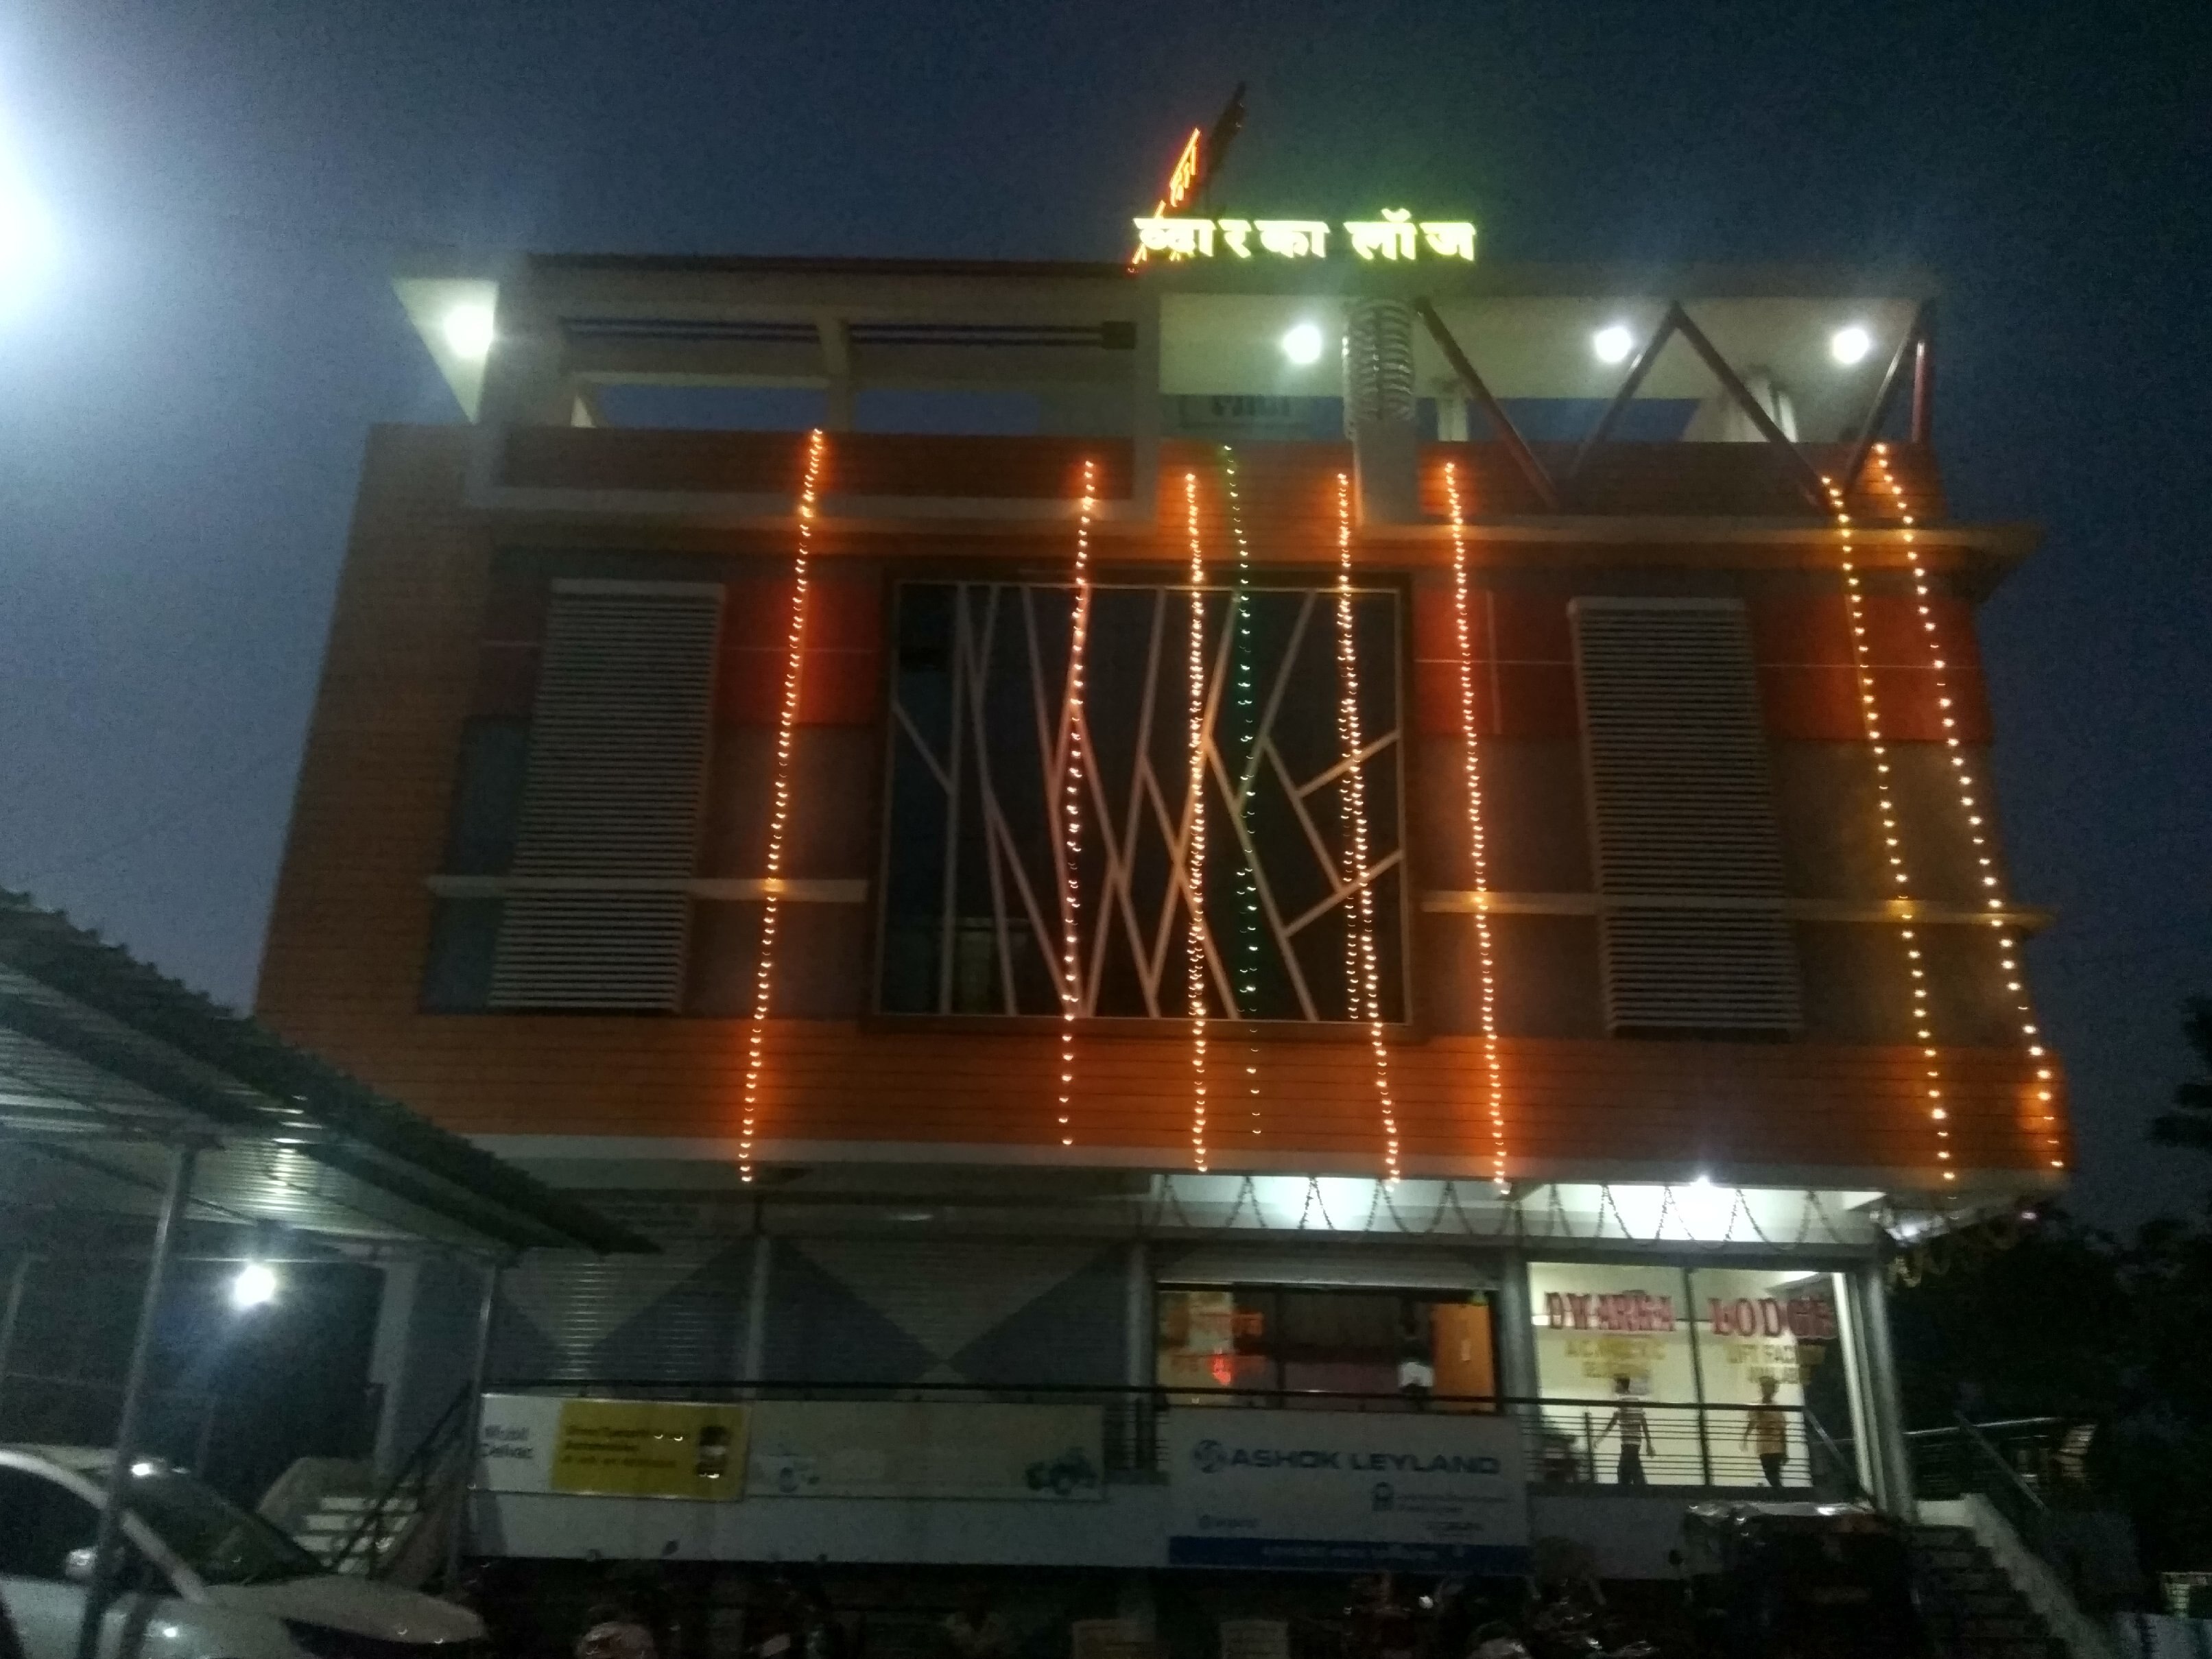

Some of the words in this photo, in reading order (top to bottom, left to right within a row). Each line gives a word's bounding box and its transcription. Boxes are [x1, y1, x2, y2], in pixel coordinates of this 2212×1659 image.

[1343, 208, 1475, 261] लॉज
[1230, 1448, 1340, 1470] ASHOK
[1349, 1453, 1501, 1475] LEYLAND
